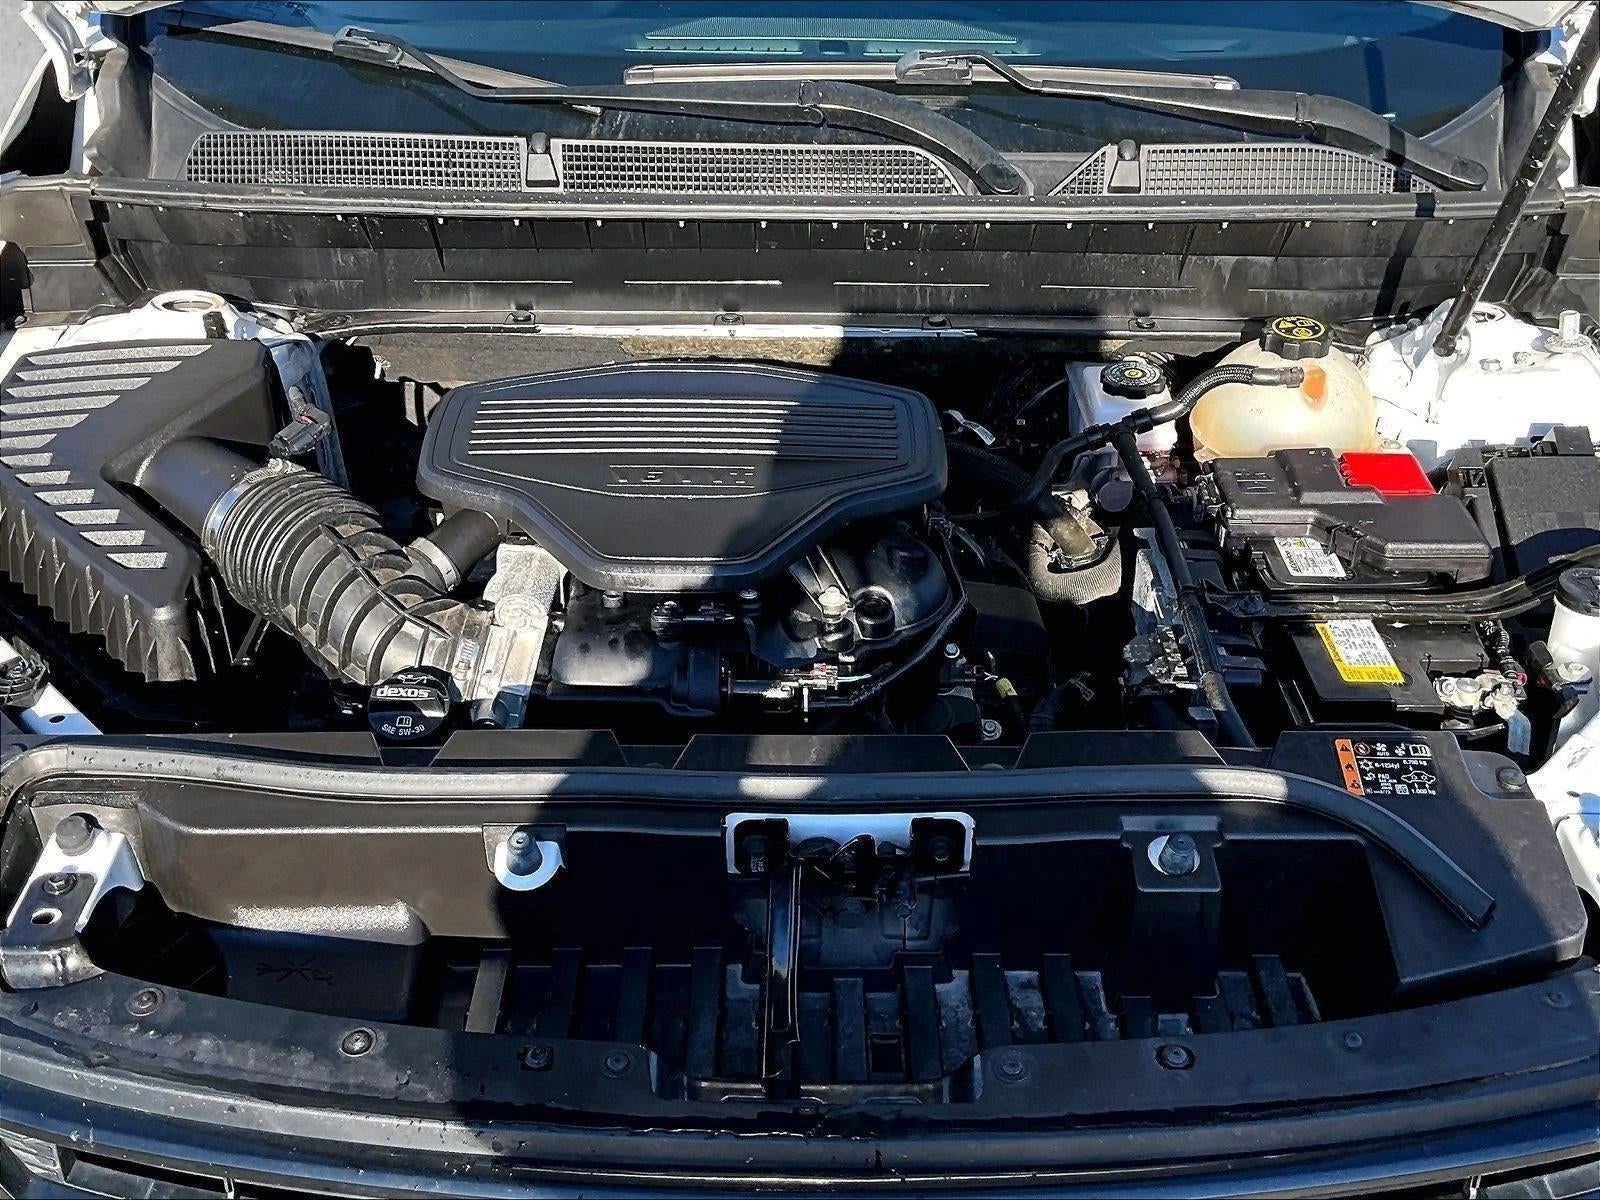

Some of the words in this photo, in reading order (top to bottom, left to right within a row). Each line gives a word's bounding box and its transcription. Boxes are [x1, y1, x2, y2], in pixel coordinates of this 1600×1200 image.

[376, 685, 431, 698] dexos
[381, 723, 397, 735] SAE
[398, 724, 426, 736] 5W-30
